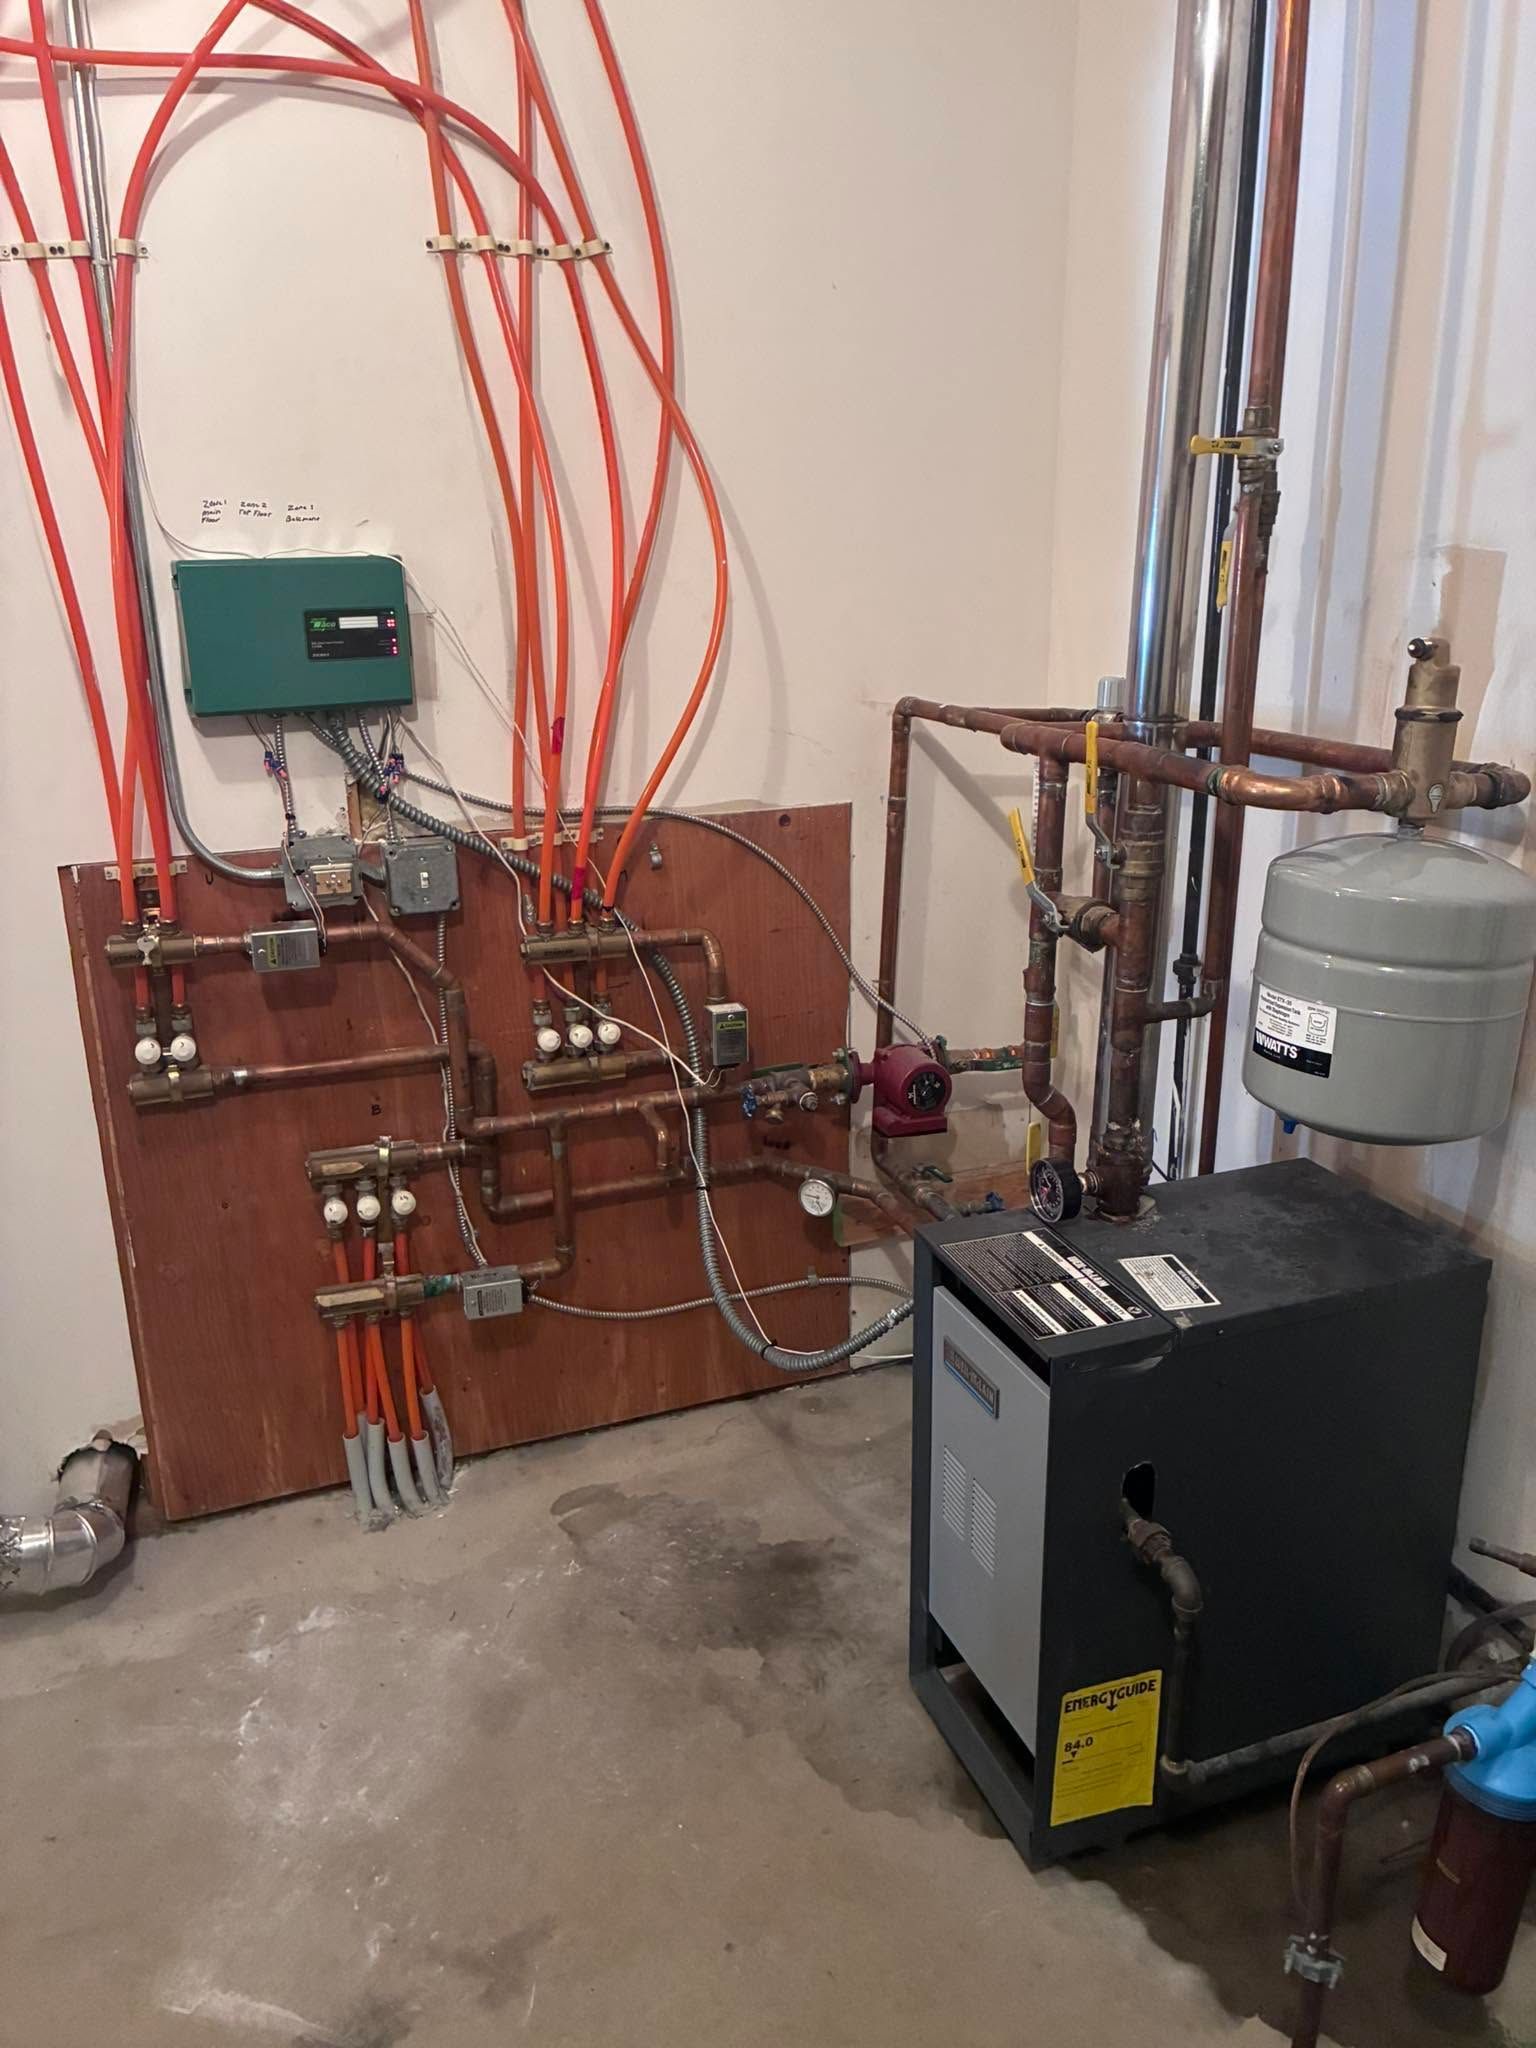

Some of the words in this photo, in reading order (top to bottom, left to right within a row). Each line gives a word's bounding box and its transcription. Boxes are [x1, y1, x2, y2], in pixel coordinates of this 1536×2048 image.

[1264, 1036, 1298, 1059] WATTS
[1064, 1679, 1157, 1713] ENERGYGUIDE
[1064, 1736, 1094, 1753] 84.0
